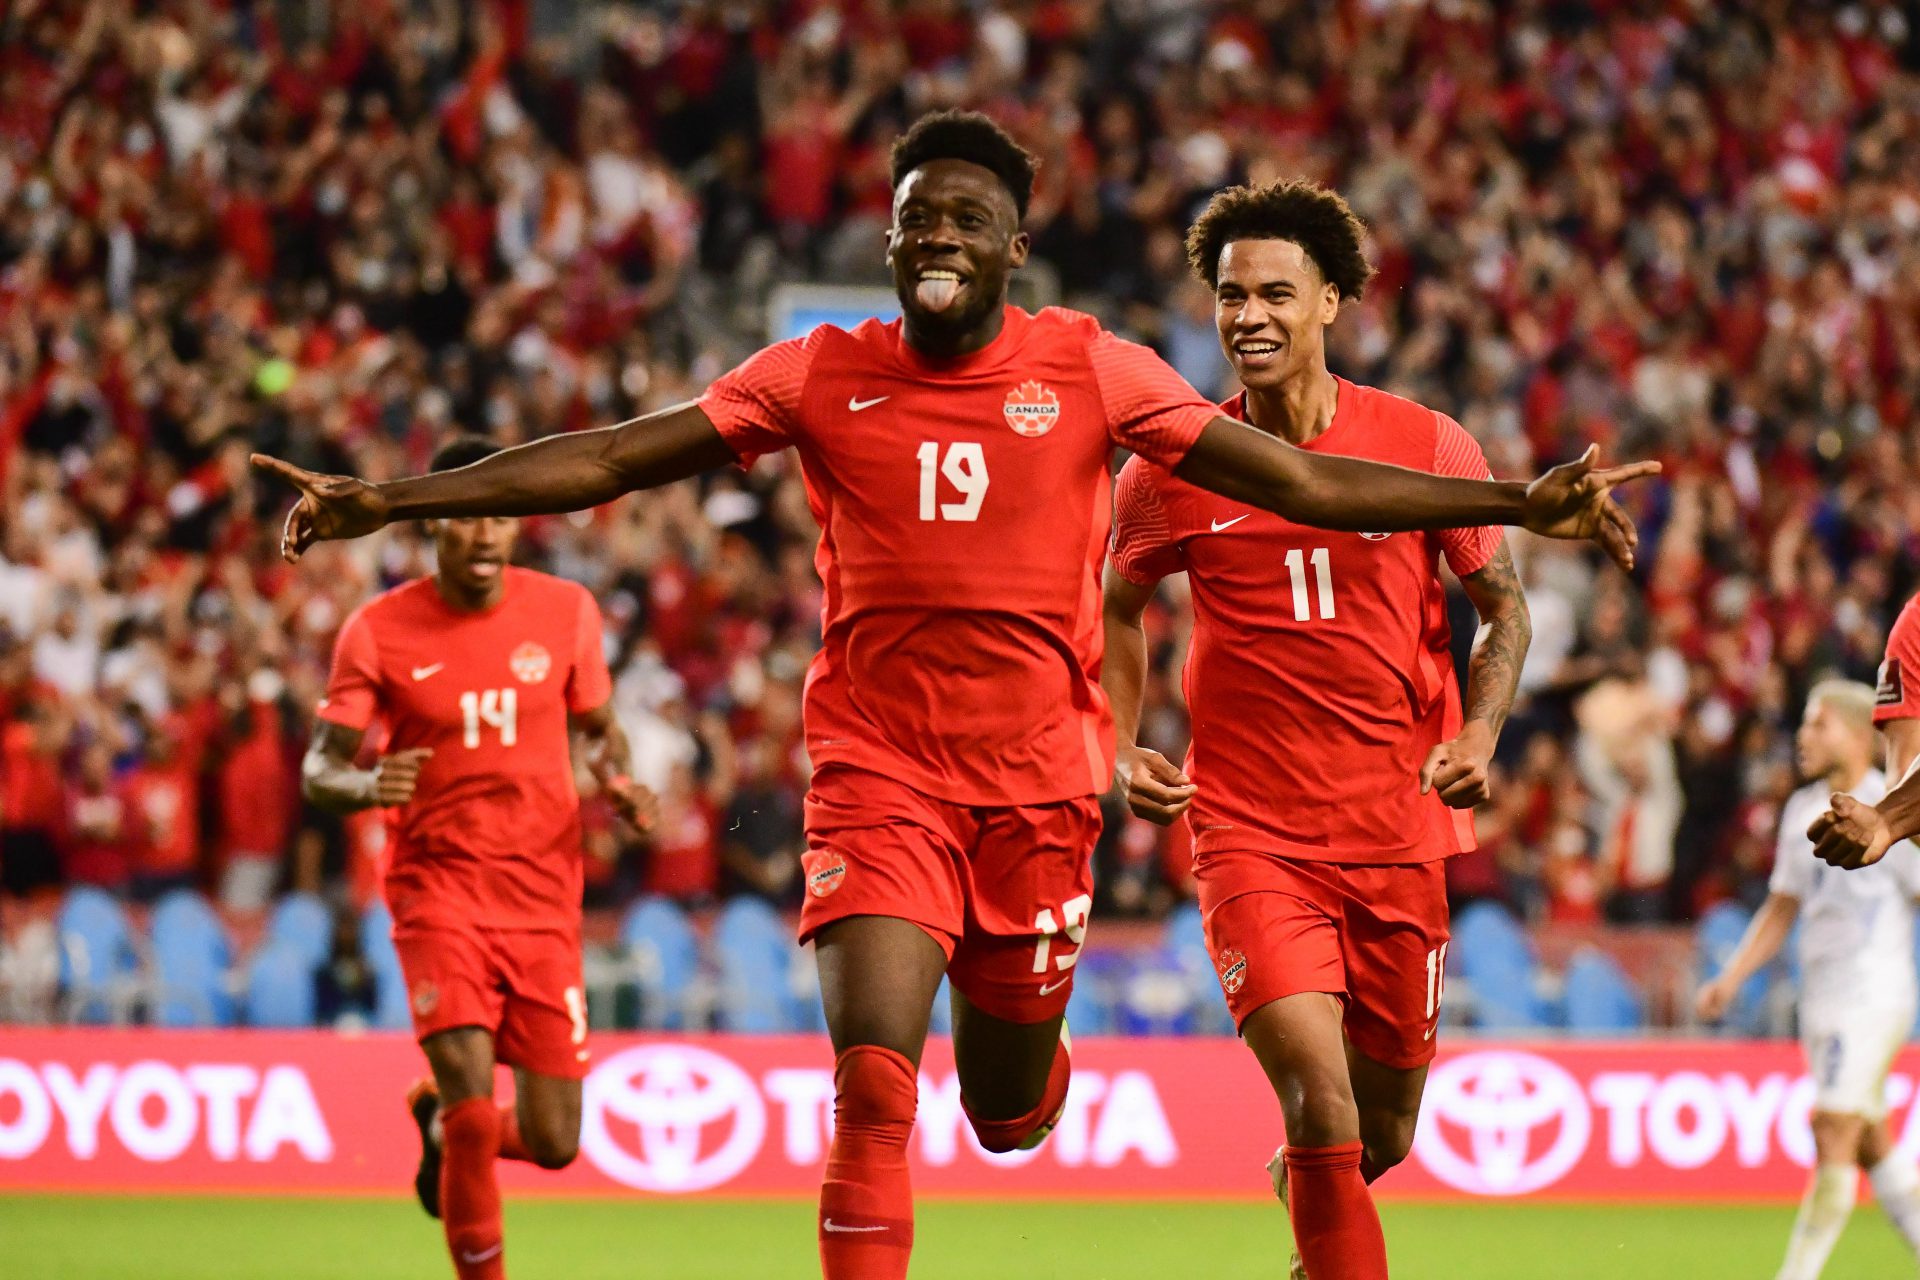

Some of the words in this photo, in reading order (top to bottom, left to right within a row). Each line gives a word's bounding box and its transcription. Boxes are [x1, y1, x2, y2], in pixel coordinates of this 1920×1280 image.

[916, 441, 990, 521] 19
[1284, 548, 1336, 622] 11
[459, 687, 517, 749] 14
[811, 866, 844, 884] ANADA
[1032, 893, 1092, 973] 19
[1222, 961, 1245, 983] CANADA
[763, 1069, 1180, 1168] TYTA
